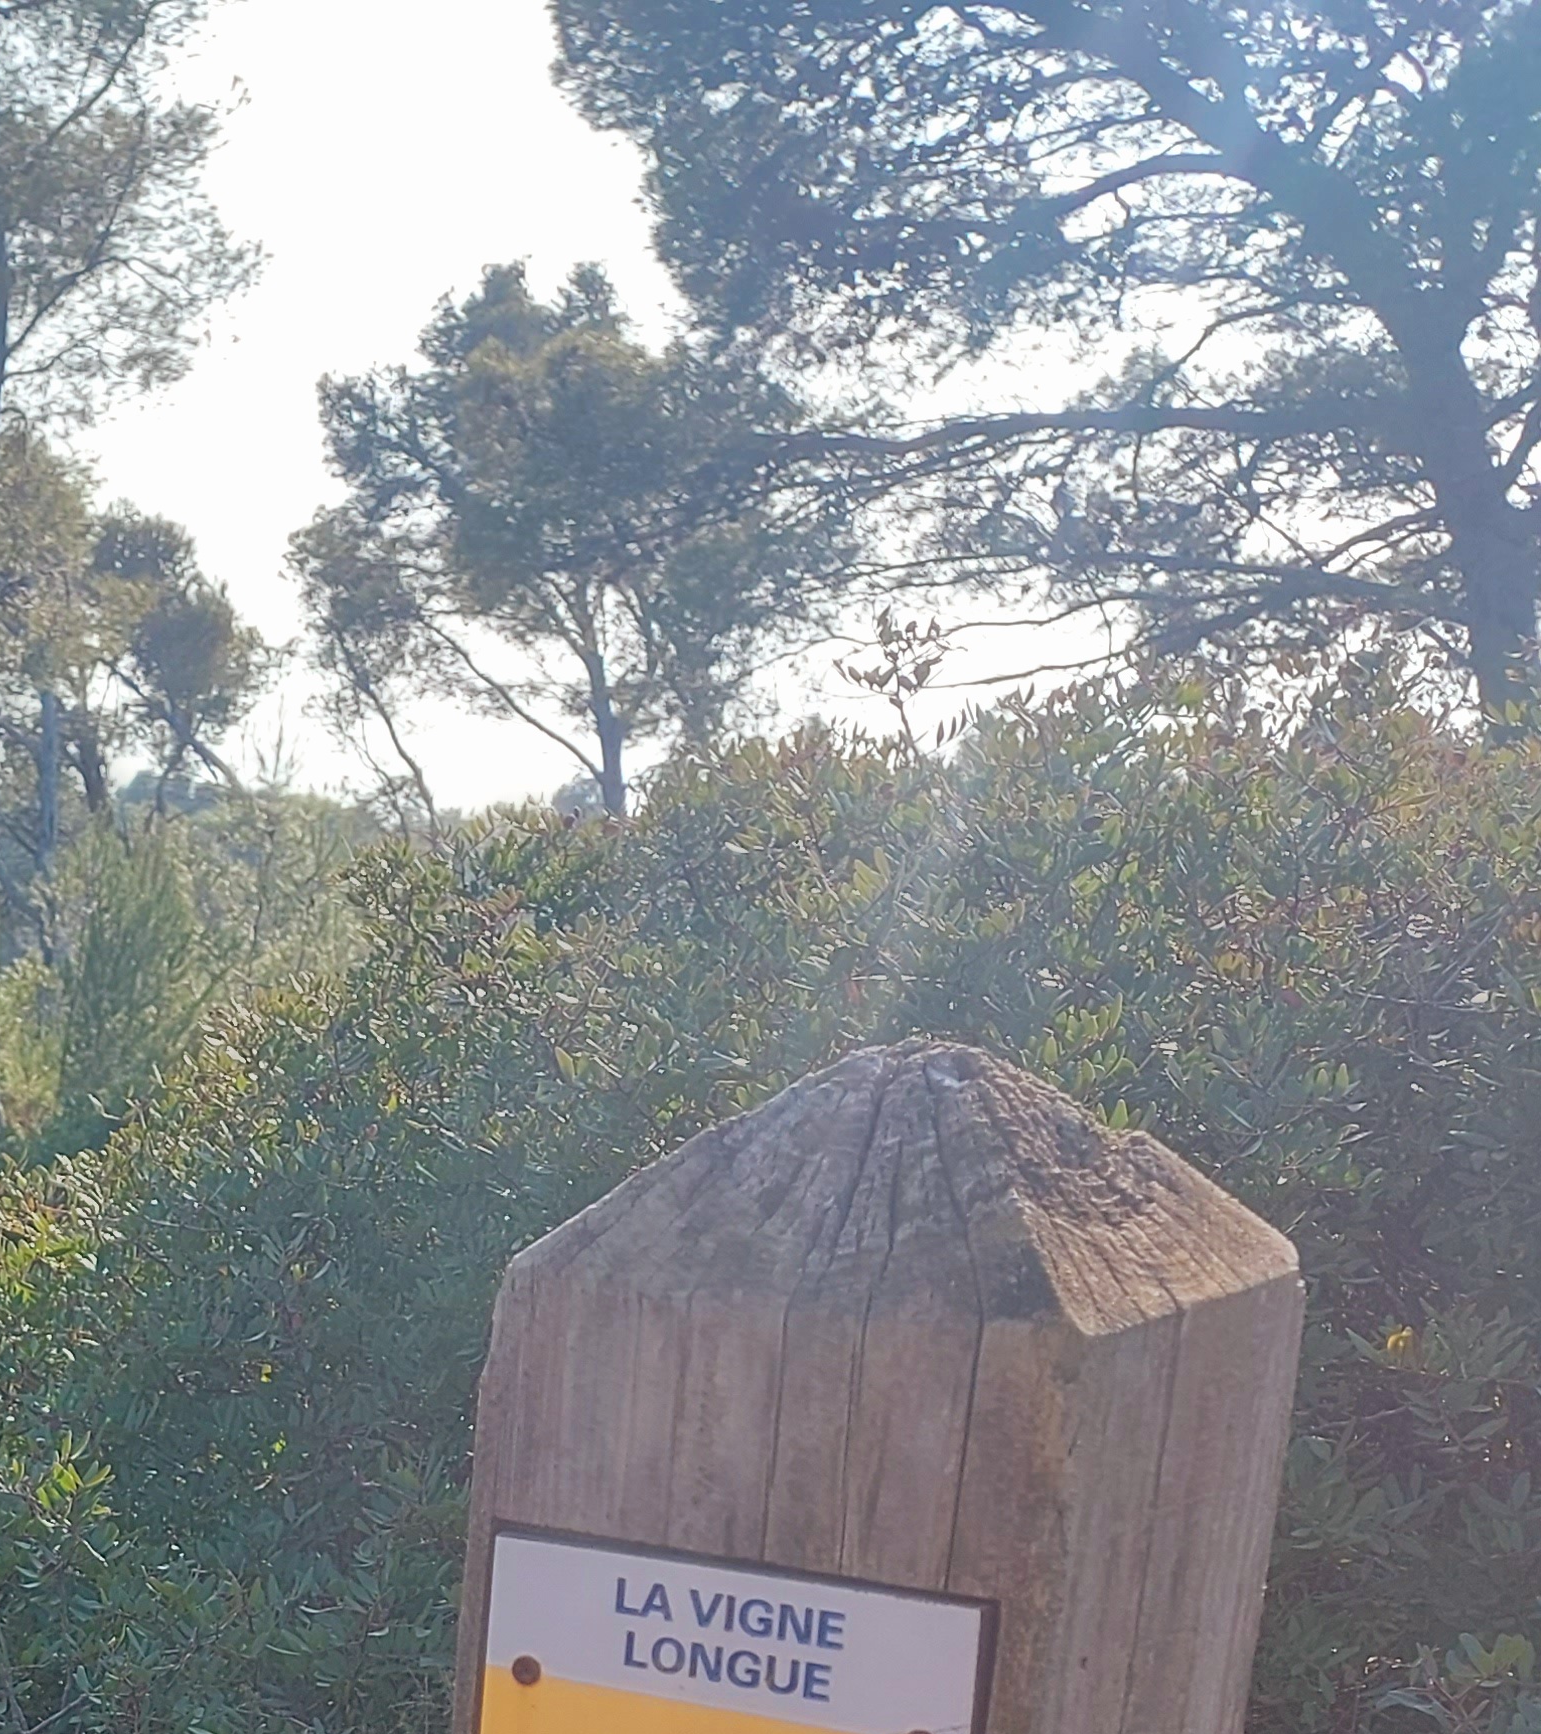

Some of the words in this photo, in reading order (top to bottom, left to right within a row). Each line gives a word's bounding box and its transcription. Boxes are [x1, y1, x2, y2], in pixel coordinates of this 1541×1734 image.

[613, 1577, 673, 1622] LA
[689, 1588, 847, 1651] VIGNE
[623, 1630, 833, 1703] LONGUE
